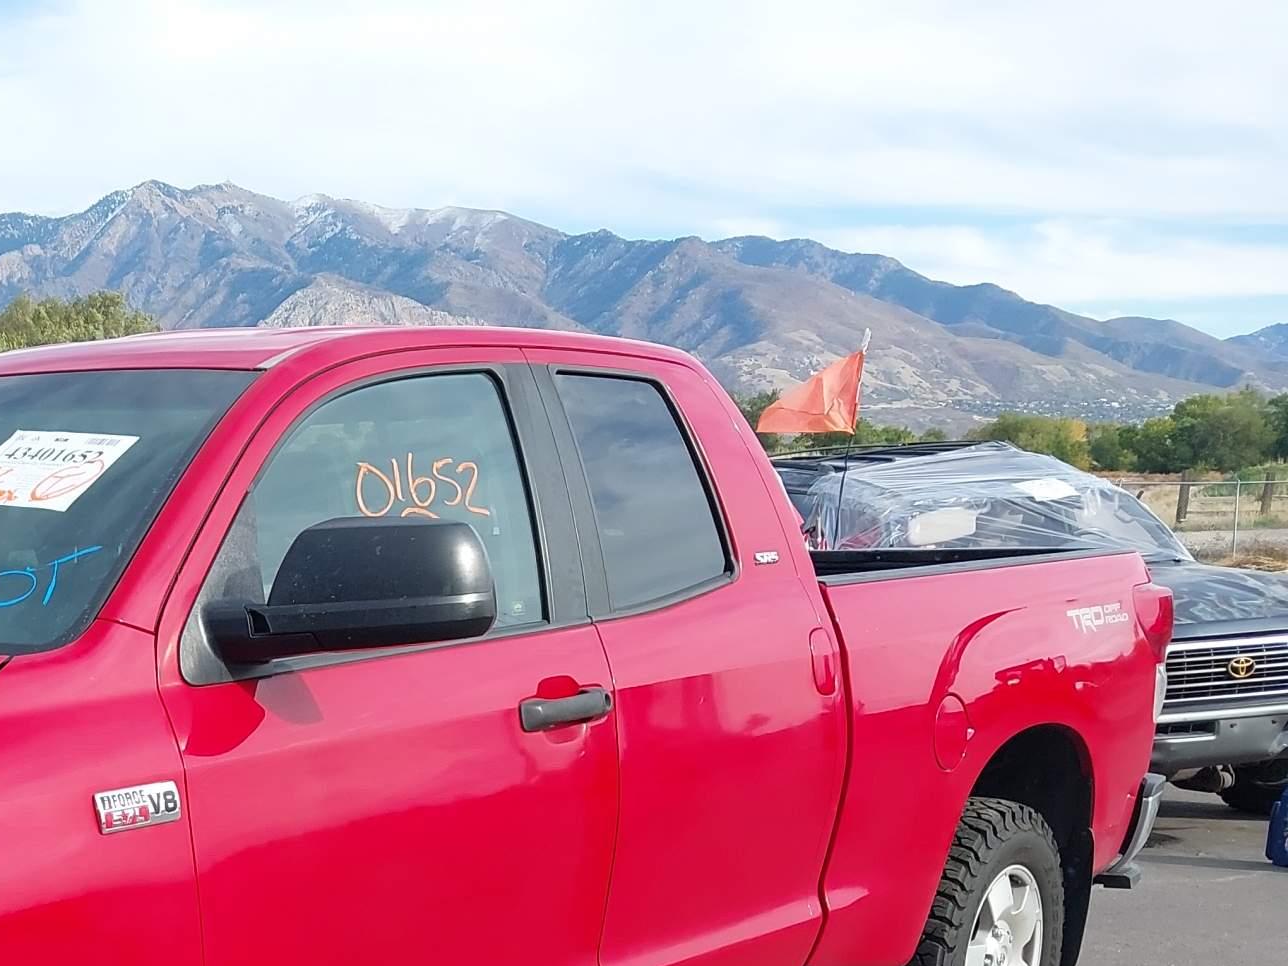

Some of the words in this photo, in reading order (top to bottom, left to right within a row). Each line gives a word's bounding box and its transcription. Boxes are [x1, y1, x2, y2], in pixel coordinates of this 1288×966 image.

[5, 446, 104, 464] 43401652
[355, 452, 491, 517] 01652
[1066, 606, 1104, 634] TRD
[148, 790, 178, 815] V8
